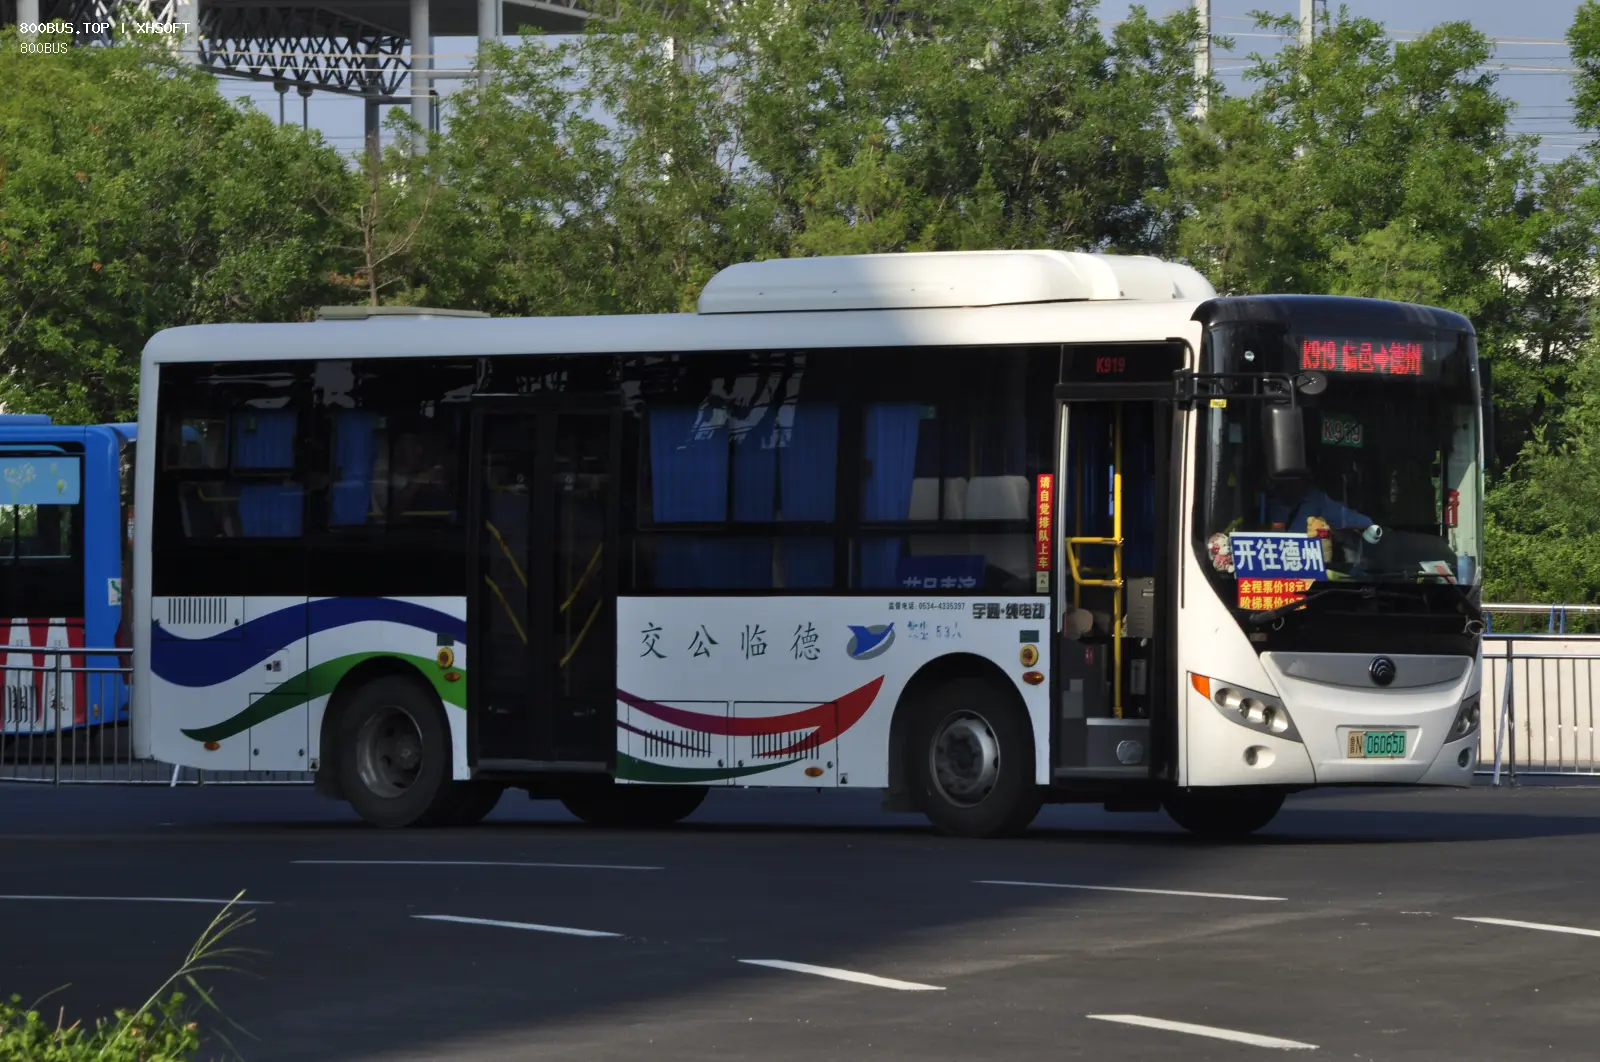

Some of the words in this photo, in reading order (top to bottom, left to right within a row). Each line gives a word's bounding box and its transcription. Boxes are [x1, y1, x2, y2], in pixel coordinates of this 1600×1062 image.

[1096, 356, 1125, 373] K919
[1303, 339, 1336, 371] K919
[1038, 475, 1051, 570] 请自觉排队上车
[1233, 538, 1325, 572] 开往德州
